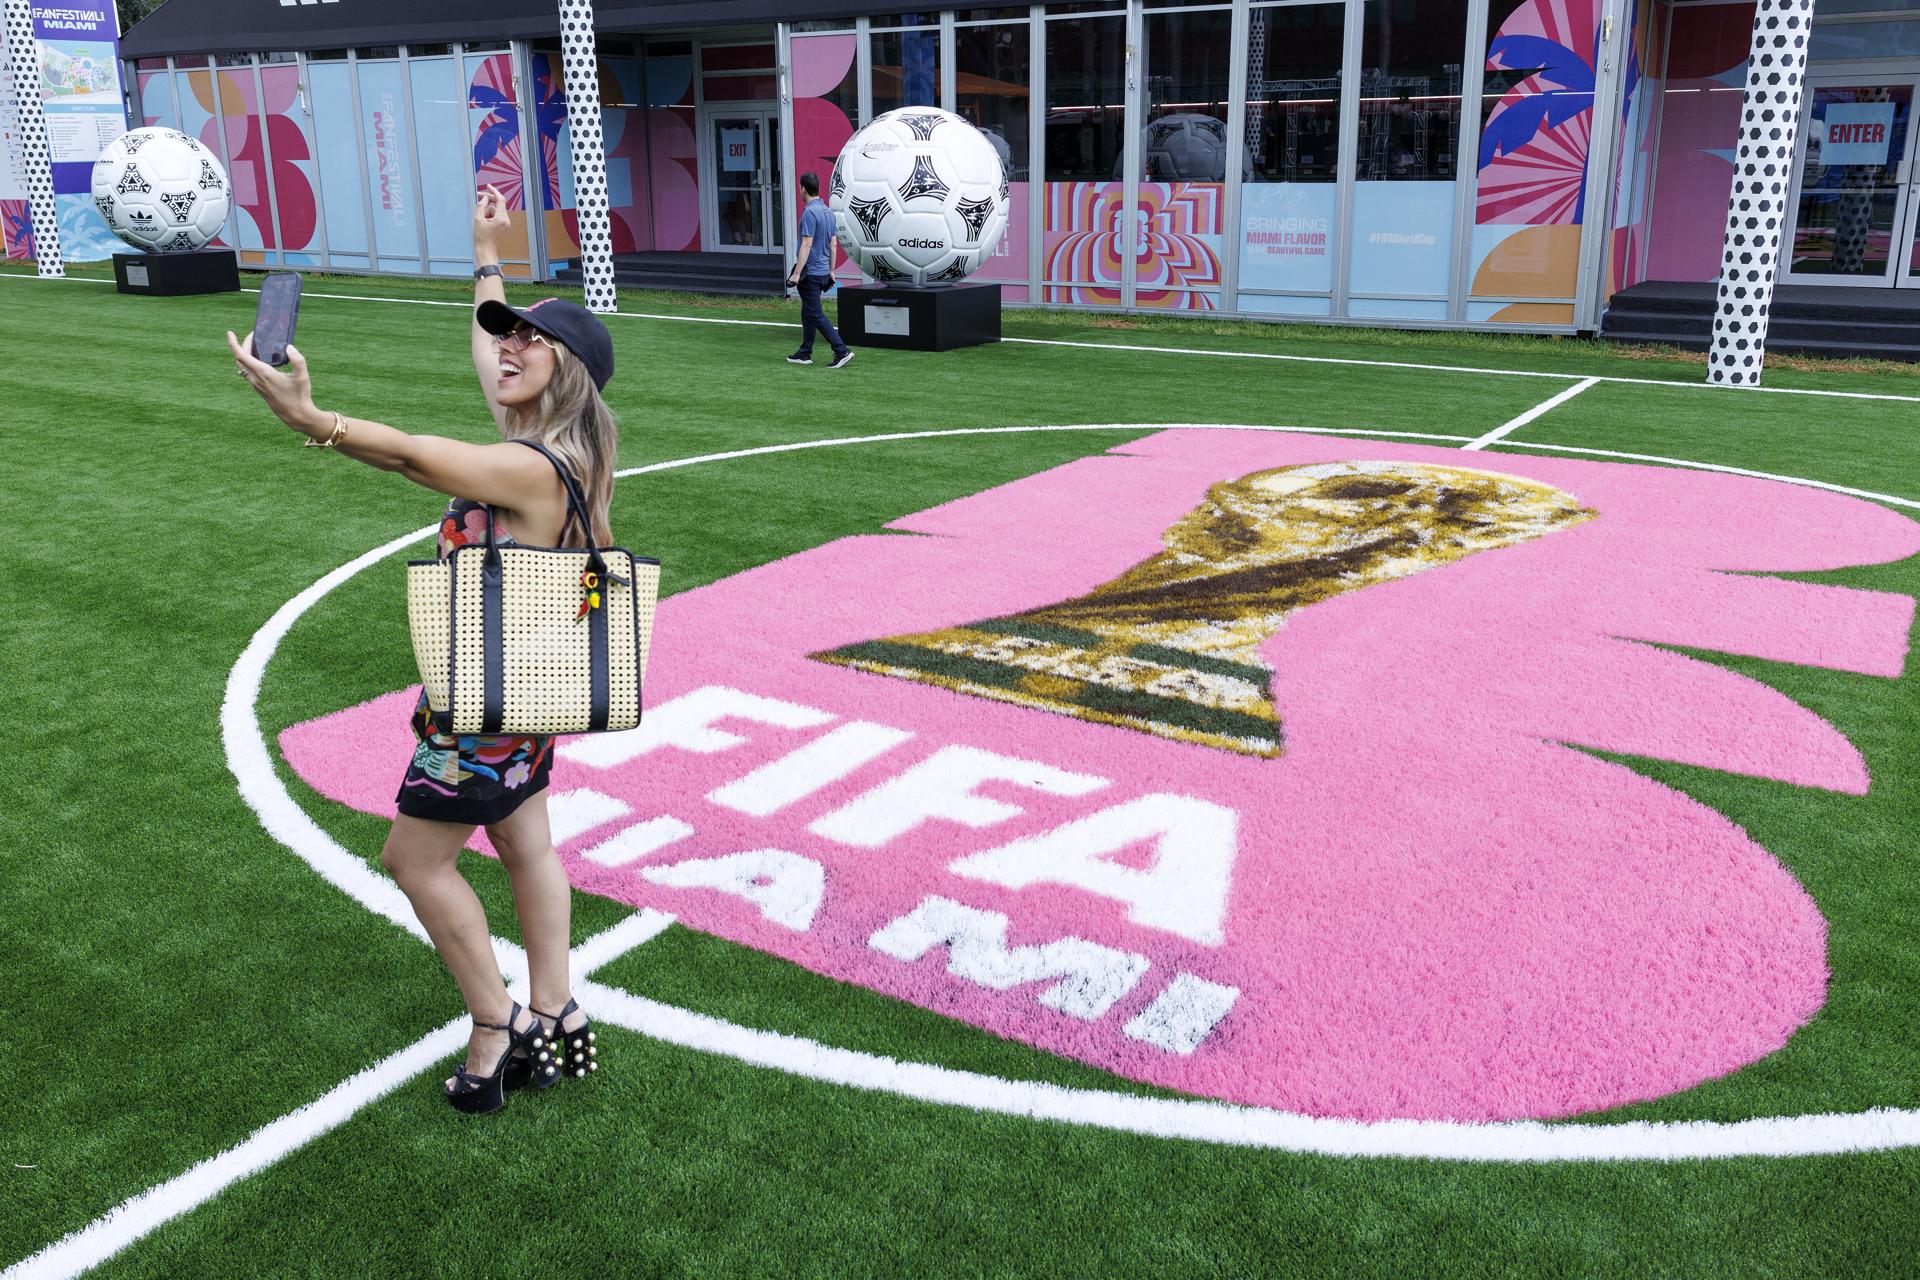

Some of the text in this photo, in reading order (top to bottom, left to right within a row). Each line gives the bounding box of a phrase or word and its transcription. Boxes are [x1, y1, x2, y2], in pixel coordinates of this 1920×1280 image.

[43, 20, 97, 30] MIAMI
[1828, 124, 1885, 143] ENTER
[729, 144, 748, 157] EXIT
[373, 111, 391, 209] MIAMI
[1247, 217, 1328, 231] BRINGING
[898, 237, 945, 249] adidas
[1247, 232, 1327, 245] MIAMI FLAVOR
[1368, 232, 1436, 247] #FIFAWorldCup
[1267, 247, 1304, 256] BEAUTIFUL
[1305, 247, 1327, 256] GAME
[553, 685, 1241, 946] FIFA
